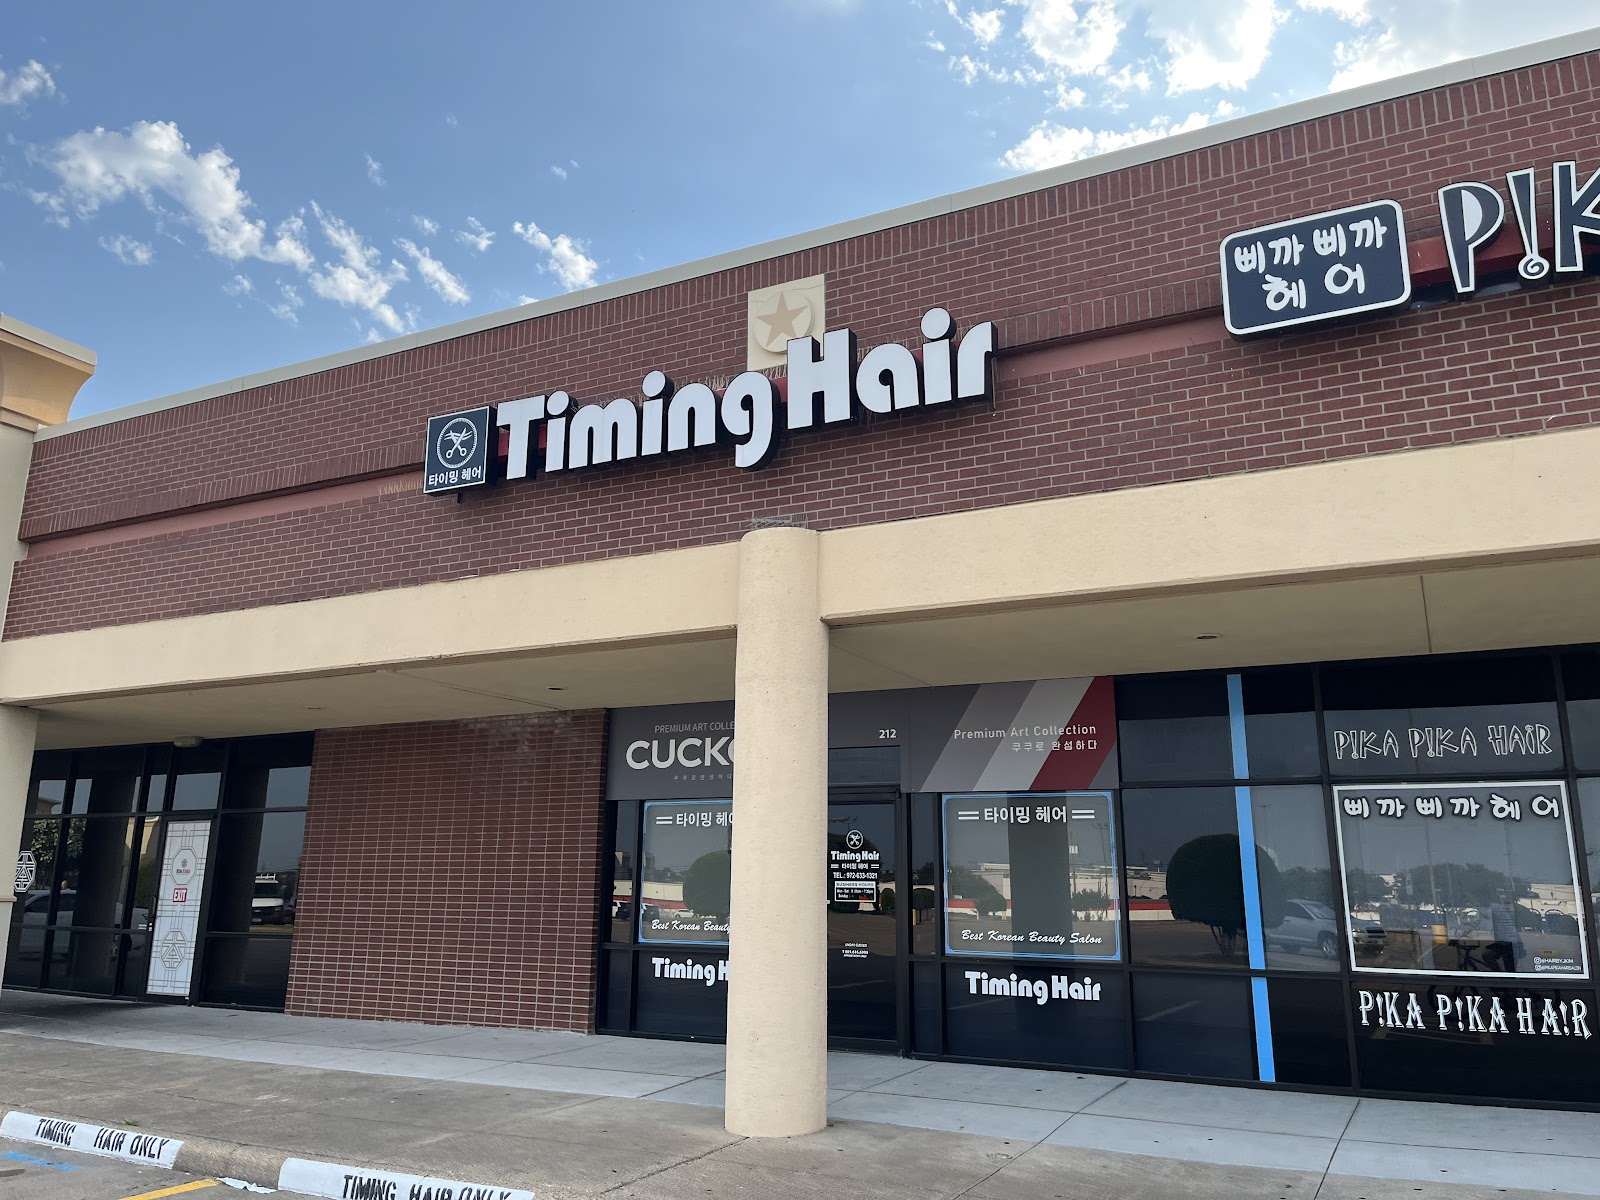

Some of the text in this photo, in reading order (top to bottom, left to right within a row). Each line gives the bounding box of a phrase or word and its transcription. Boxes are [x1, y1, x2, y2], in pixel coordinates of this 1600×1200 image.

[1234, 216, 1388, 273] 삐까 삐까
[497, 307, 993, 468] Timing Hair
[428, 465, 482, 486] 타이밍 헤어
[654, 723, 691, 734] PREMIUM
[692, 722, 708, 732] ART
[878, 729, 897, 739] 212
[954, 724, 1096, 740] Premium Art Collection
[625, 736, 735, 770] CUCK
[676, 812, 712, 827] 타이밍
[984, 805, 1067, 824] 타이밍 헤어
[831, 851, 880, 862] Timing Hair
[174, 890, 187, 901] EXIT
[651, 919, 669, 930] Best
[671, 920, 701, 931] Korean
[961, 929, 1103, 945] Best Korean Beauty Salon
[651, 957, 716, 987] Timing
[964, 971, 1102, 1005] Timing Hair
[35, 1118, 170, 1159] TIMING HAIR ONLY
[343, 1174, 397, 1200] TIMING
